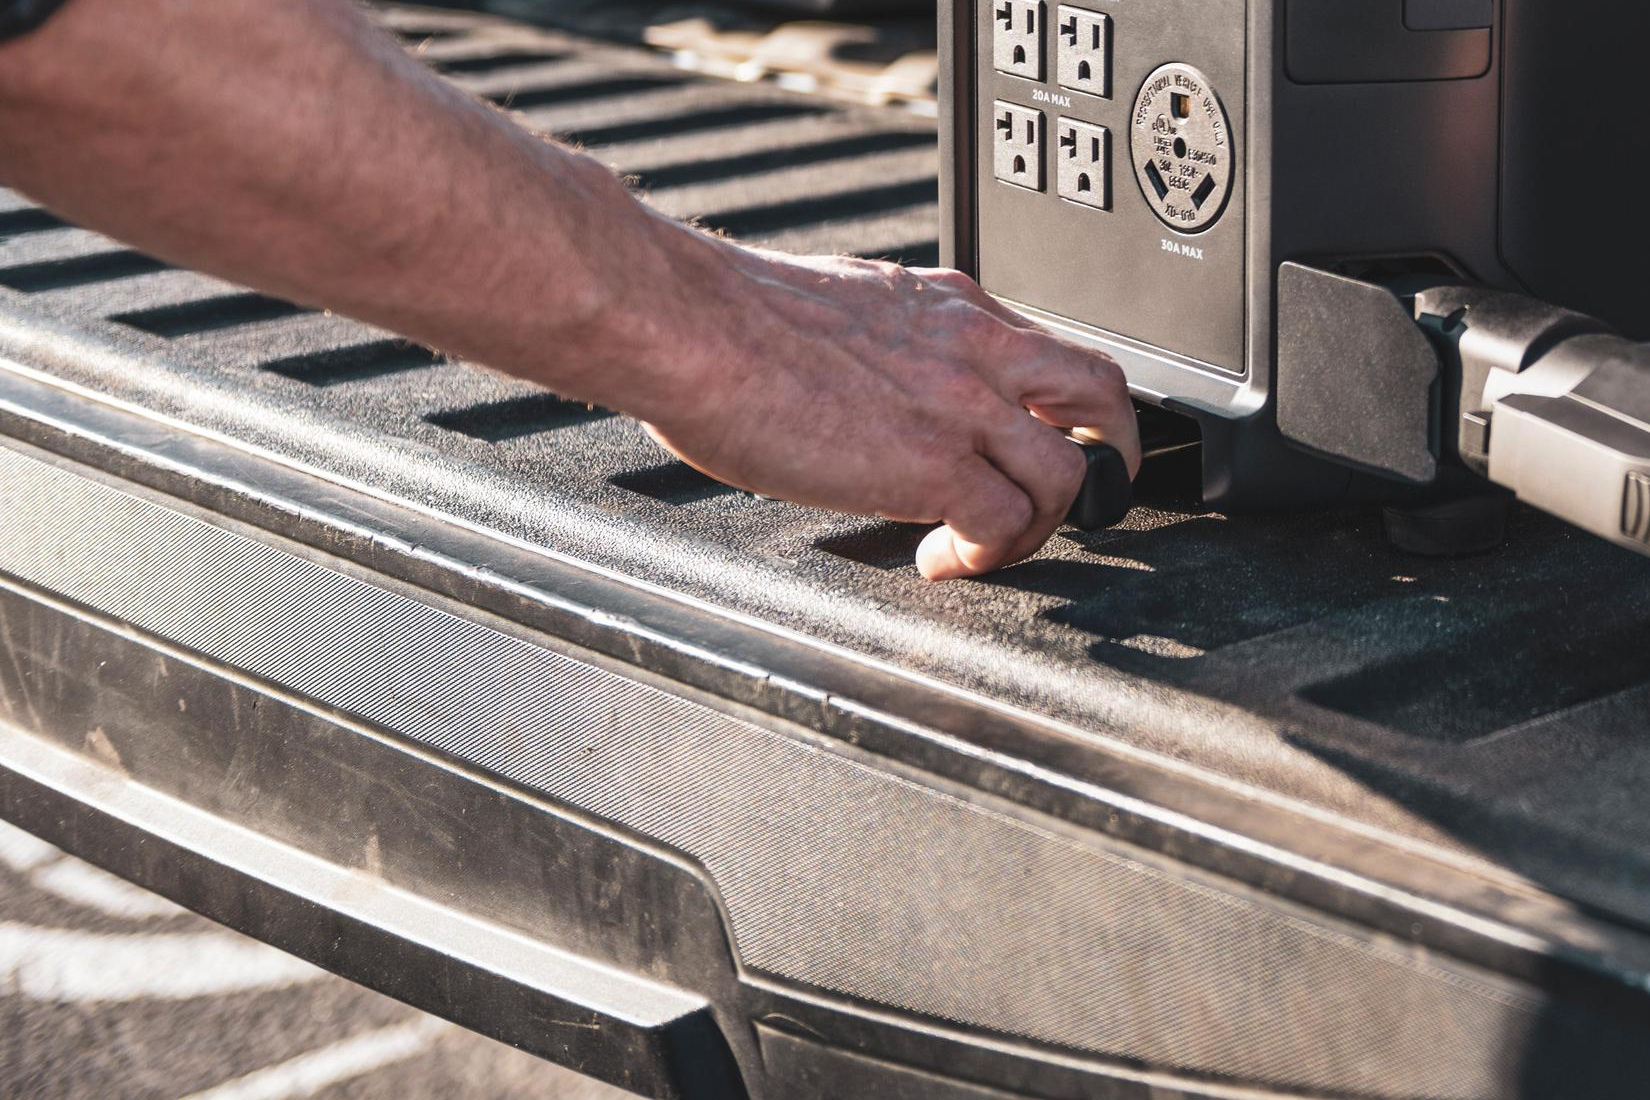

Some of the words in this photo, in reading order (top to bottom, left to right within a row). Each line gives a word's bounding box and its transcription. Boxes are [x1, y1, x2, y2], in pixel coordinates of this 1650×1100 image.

[1032, 89, 1050, 103] 20A
[1051, 93, 1071, 108] MAX
[1161, 239, 1180, 254] 30A
[1181, 244, 1204, 260] MAX
